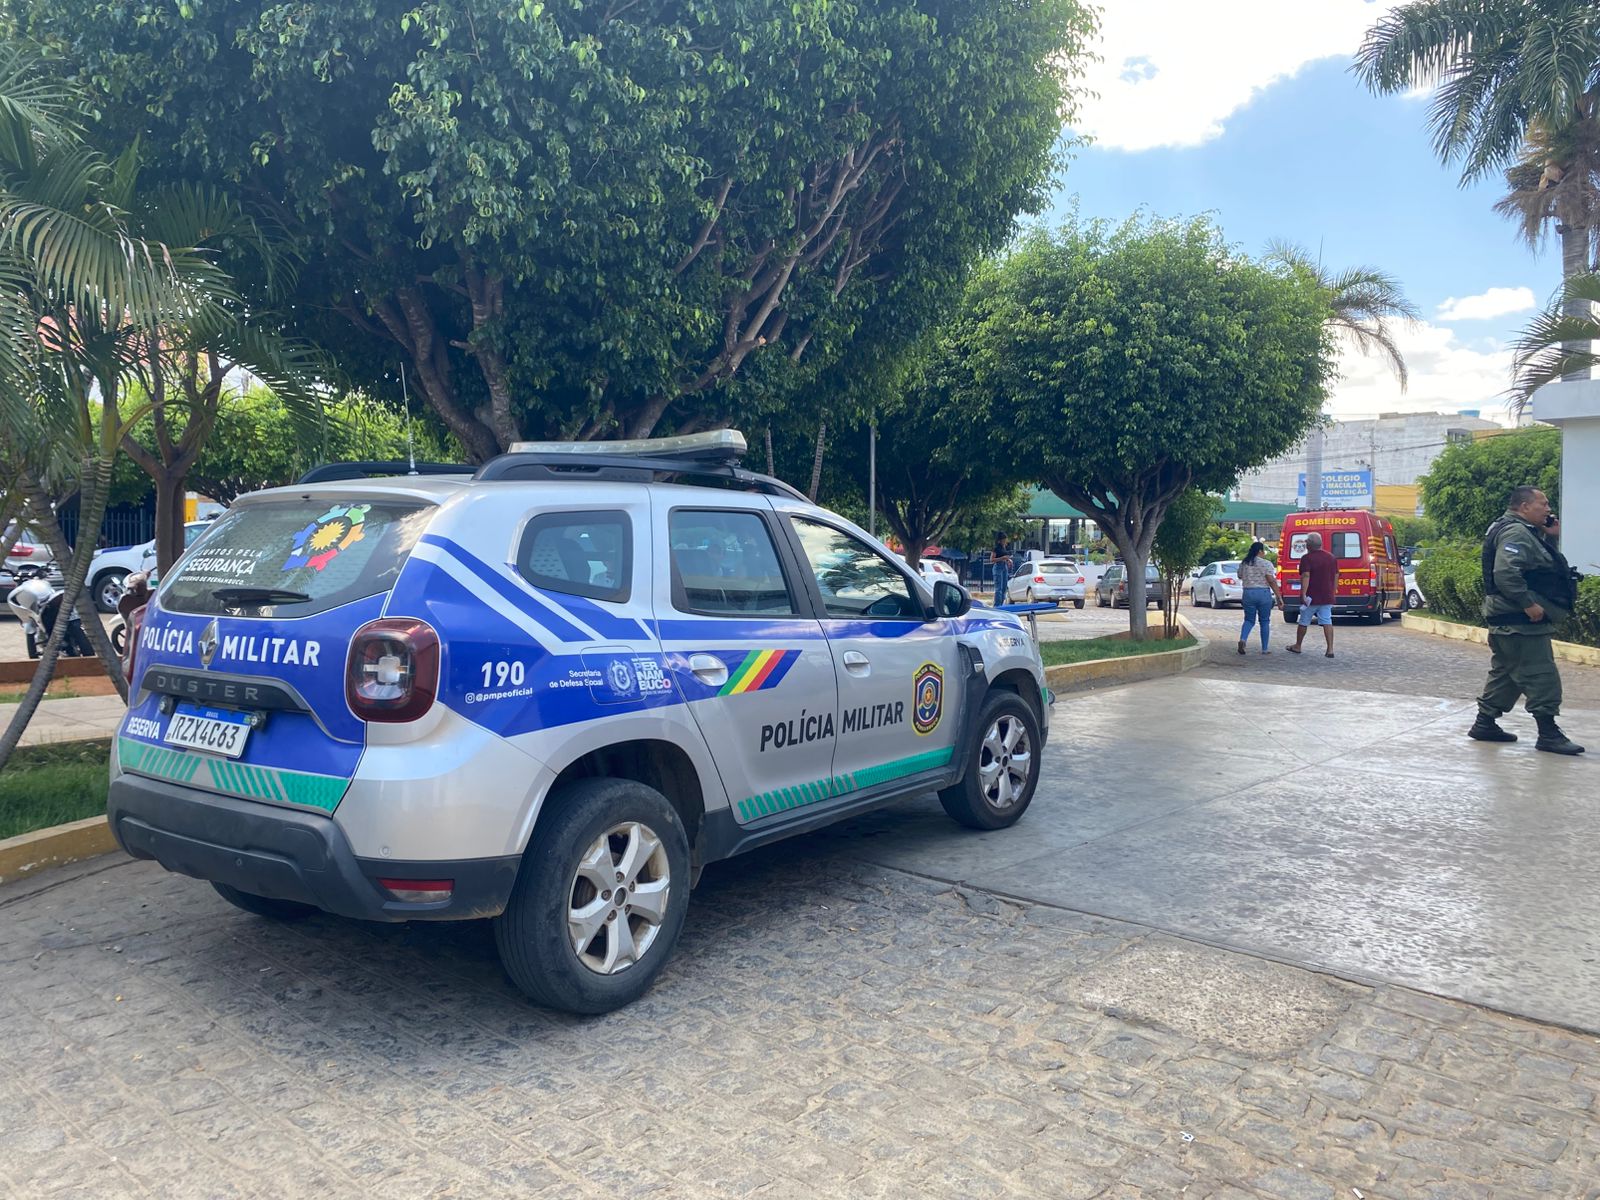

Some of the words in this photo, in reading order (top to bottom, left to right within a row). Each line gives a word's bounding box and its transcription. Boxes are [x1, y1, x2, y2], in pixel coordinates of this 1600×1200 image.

[1295, 517, 1357, 527] BOMBEIROS
[236, 548, 263, 558] PELA
[185, 558, 257, 577] SEGURANÇA
[1338, 578, 1369, 586] SGATE
[142, 621, 193, 654] POLÍCIA
[221, 635, 321, 667] MILITAR
[481, 660, 525, 688] 190
[549, 680, 559, 688] de
[559, 679, 584, 688] Defesa
[584, 678, 604, 687] Social
[568, 669, 602, 678] Secretaria
[156, 675, 259, 700] DUSTER
[475, 687, 533, 703] @pmpeoficial
[126, 716, 161, 740] RESERVA
[171, 716, 240, 750] RZX4C63
[760, 709, 834, 753] POLÍCIA
[842, 701, 904, 734] MILITAR
